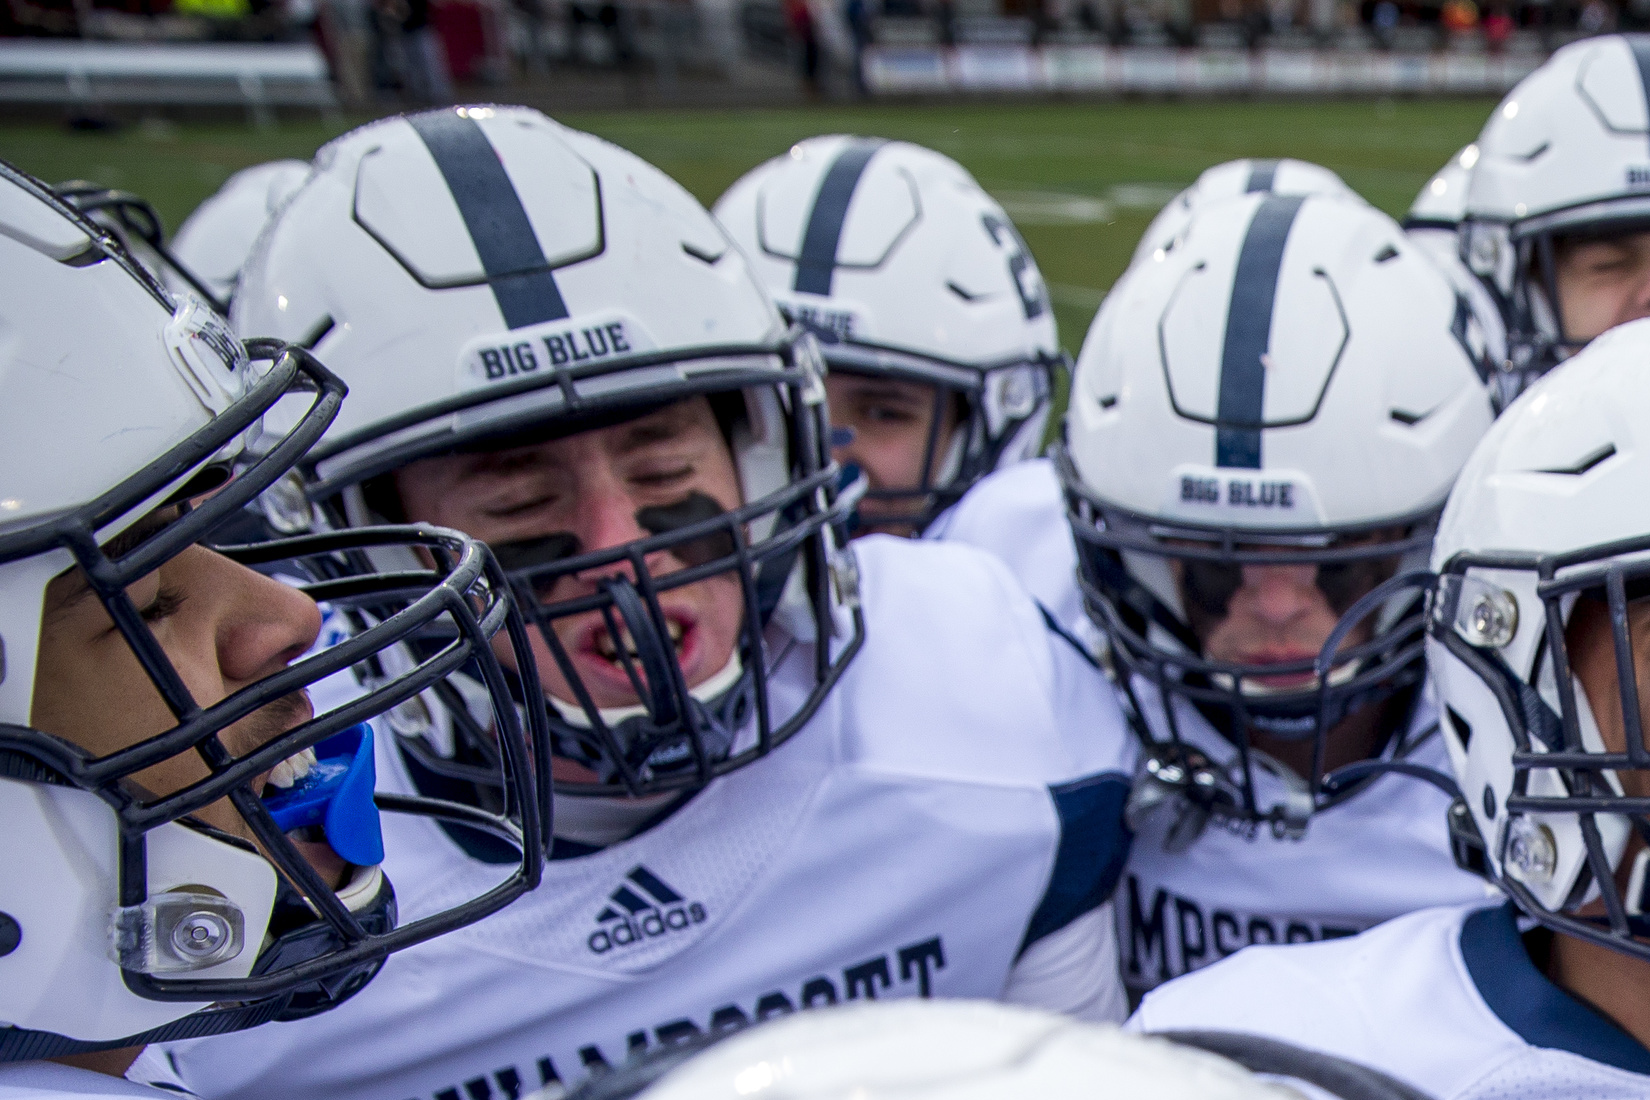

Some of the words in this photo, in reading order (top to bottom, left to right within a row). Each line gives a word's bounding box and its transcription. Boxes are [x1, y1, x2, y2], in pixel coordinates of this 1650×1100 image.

[477, 340, 539, 381] BIG
[542, 321, 631, 366] BLUE
[1180, 474, 1220, 503] BIG
[1228, 479, 1294, 509] BLUE
[586, 901, 708, 955] adidas
